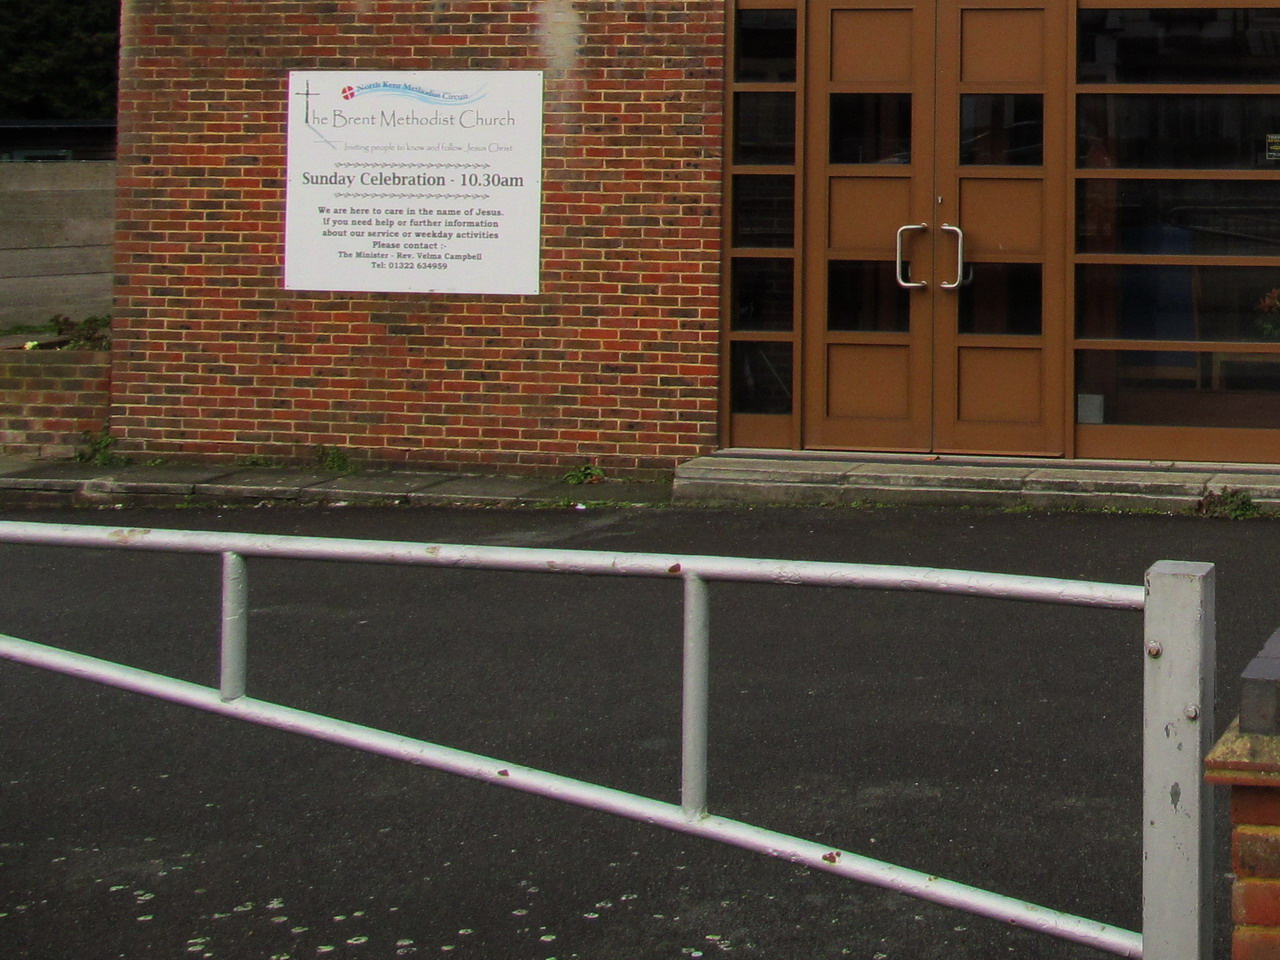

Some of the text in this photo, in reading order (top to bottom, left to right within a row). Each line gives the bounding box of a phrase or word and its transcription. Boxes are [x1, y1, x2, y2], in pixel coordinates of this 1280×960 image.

[357, 82, 380, 92] North
[403, 83, 440, 98] Methodist
[442, 92, 468, 100] Circuit
[332, 110, 376, 128] Brent
[381, 110, 456, 127] Methodist
[459, 110, 516, 128] Church
[370, 143, 395, 152] people
[406, 142, 425, 151] know
[426, 143, 440, 151] and
[441, 142, 462, 151] follow
[464, 143, 487, 153] Jesus
[488, 143, 513, 152] Christ
[302, 172, 356, 188] Sunday
[360, 172, 446, 186] Celebration
[460, 174, 524, 187] 10.30am
[464, 208, 474, 216] of
[476, 208, 504, 216] Jesus.
[351, 218, 372, 226] need
[375, 218, 395, 228] help
[410, 218, 442, 227] further
[445, 219, 499, 228] information
[322, 229, 347, 237] about
[368, 230, 400, 238] service
[414, 230, 453, 240] weekday
[456, 231, 499, 239] activities
[372, 241, 401, 249] Please
[417, 252, 442, 260] Velma
[445, 253, 482, 261] Campbell
